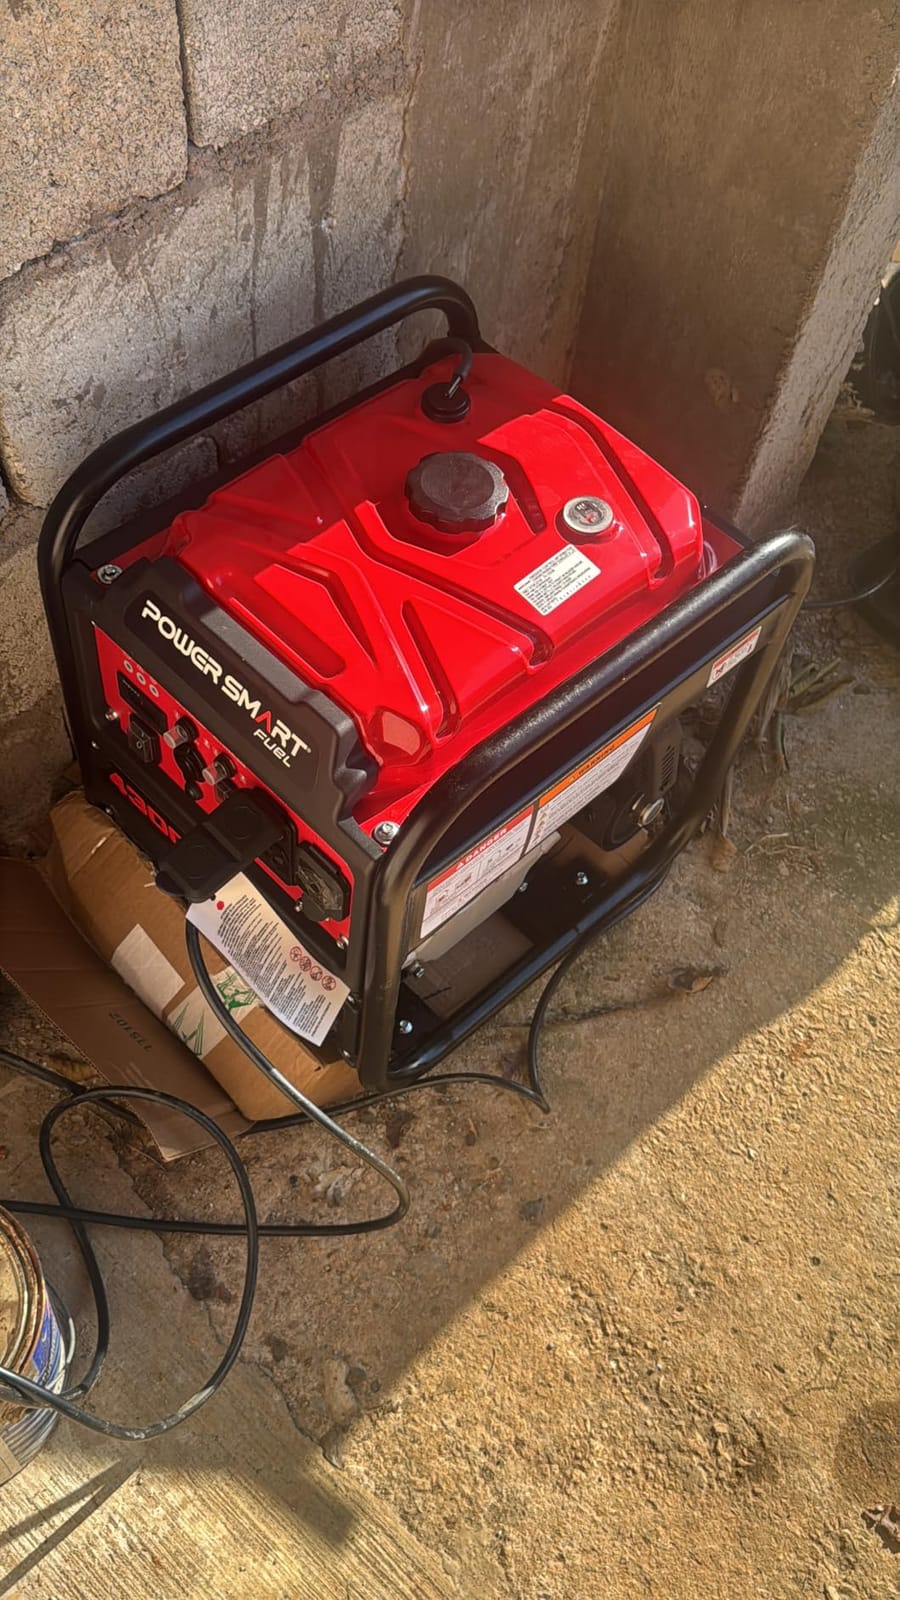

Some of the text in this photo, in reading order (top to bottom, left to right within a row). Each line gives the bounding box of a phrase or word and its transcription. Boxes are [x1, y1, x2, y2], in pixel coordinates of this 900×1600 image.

[141, 600, 223, 685] POWER
[253, 729, 291, 768] FUEL
[465, 828, 507, 863] DANGER
